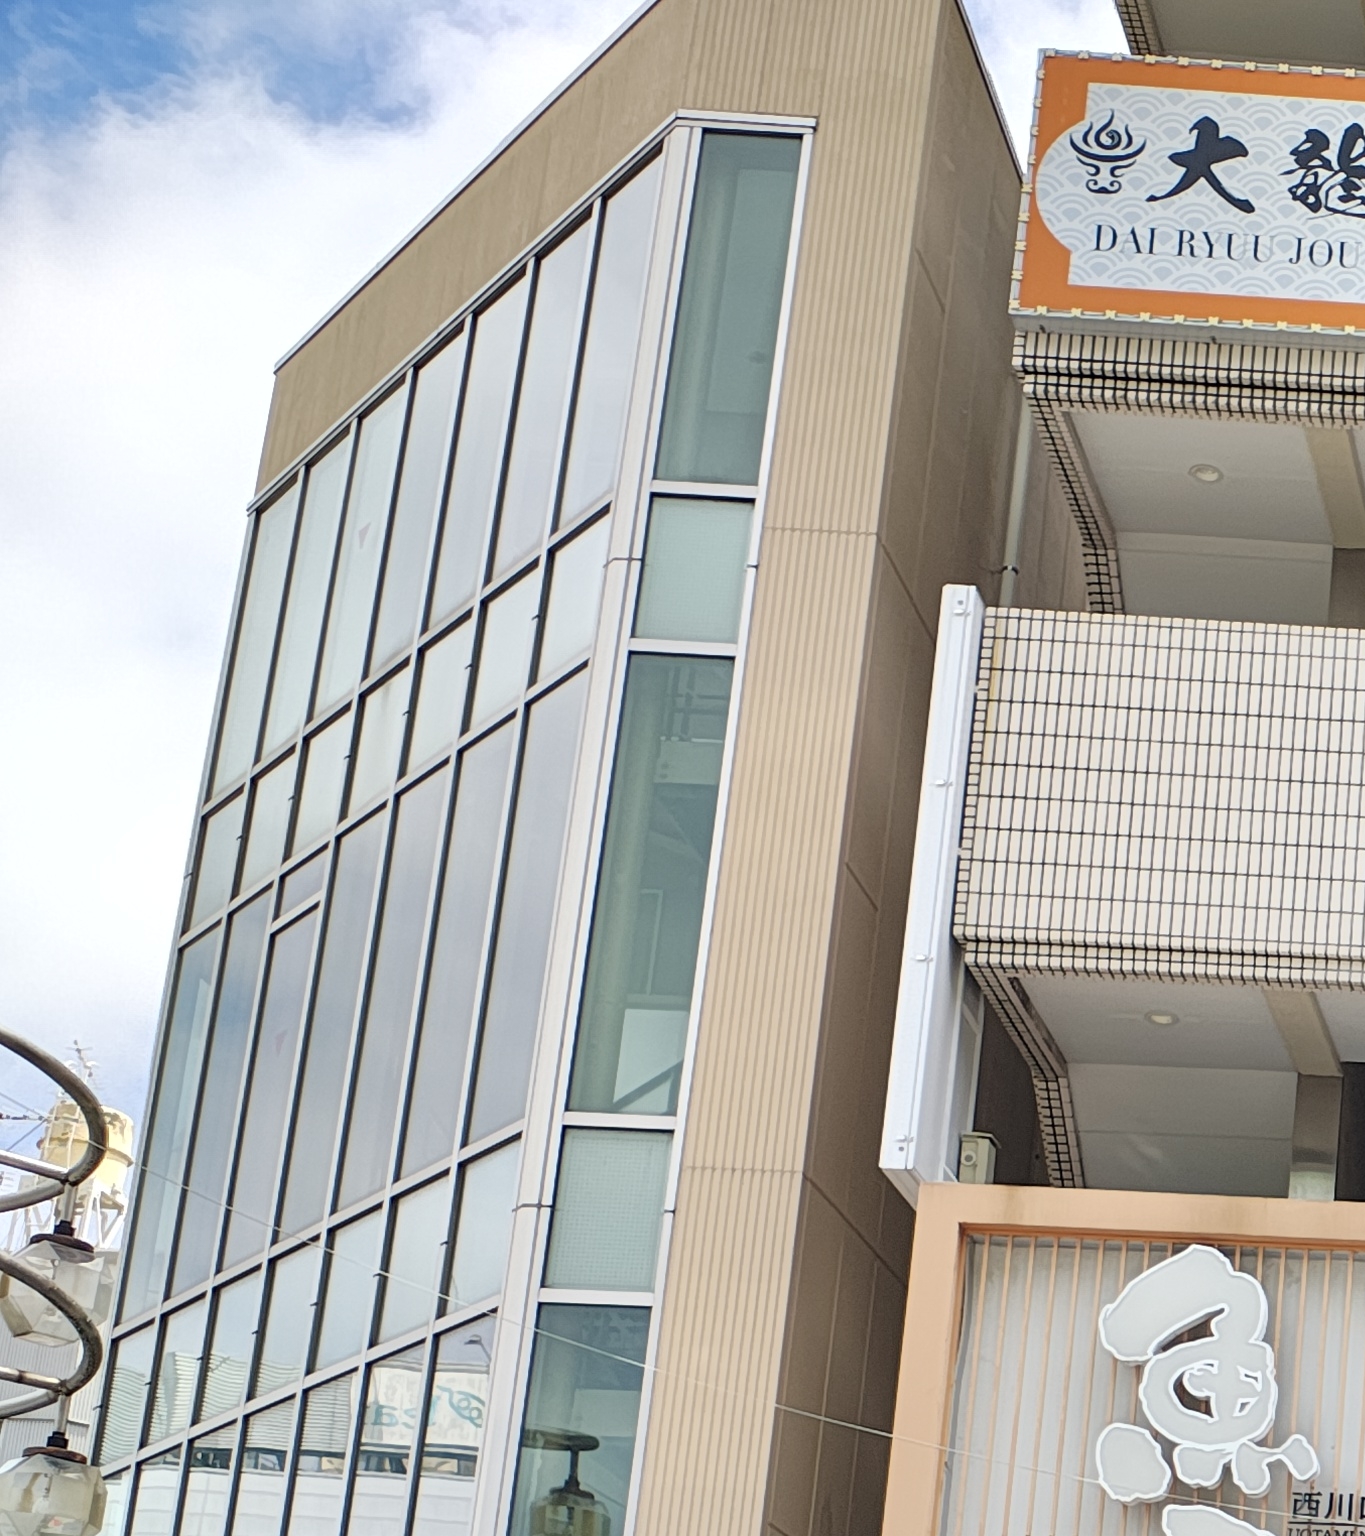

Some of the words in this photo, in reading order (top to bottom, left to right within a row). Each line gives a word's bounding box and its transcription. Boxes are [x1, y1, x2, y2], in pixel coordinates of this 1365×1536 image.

[1094, 223, 1158, 256] DAI
[1175, 229, 1276, 263] RYUU
[1288, 236, 1361, 269] JOU
